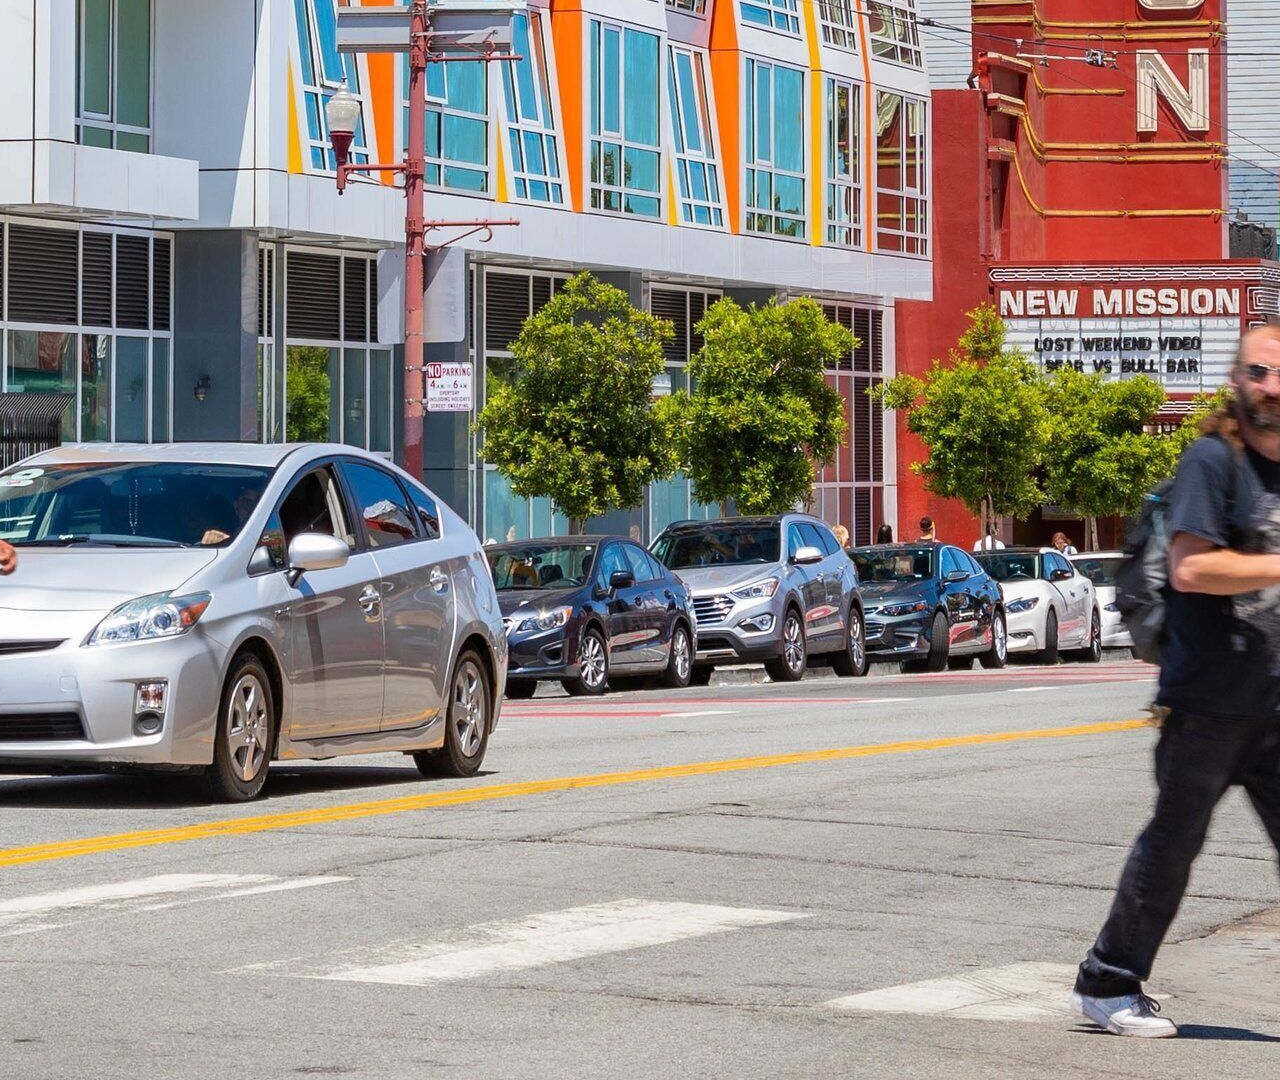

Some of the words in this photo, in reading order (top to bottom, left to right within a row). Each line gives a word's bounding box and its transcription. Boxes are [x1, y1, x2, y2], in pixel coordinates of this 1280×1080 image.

[1000, 289, 1079, 316] NEW
[1093, 288, 1240, 316] MISSION
[1034, 336, 1074, 352] LOST
[1082, 336, 1152, 352] WEEKEND
[1158, 336, 1202, 351] VIDEO
[428, 365, 441, 377] NO
[442, 368, 471, 377] PARKING
[1093, 359, 1112, 373] VS
[1121, 358, 1159, 373] BULL
[1166, 358, 1199, 373] BAR
[431, 380, 436, 389] 4
[453, 380, 458, 389] 6
